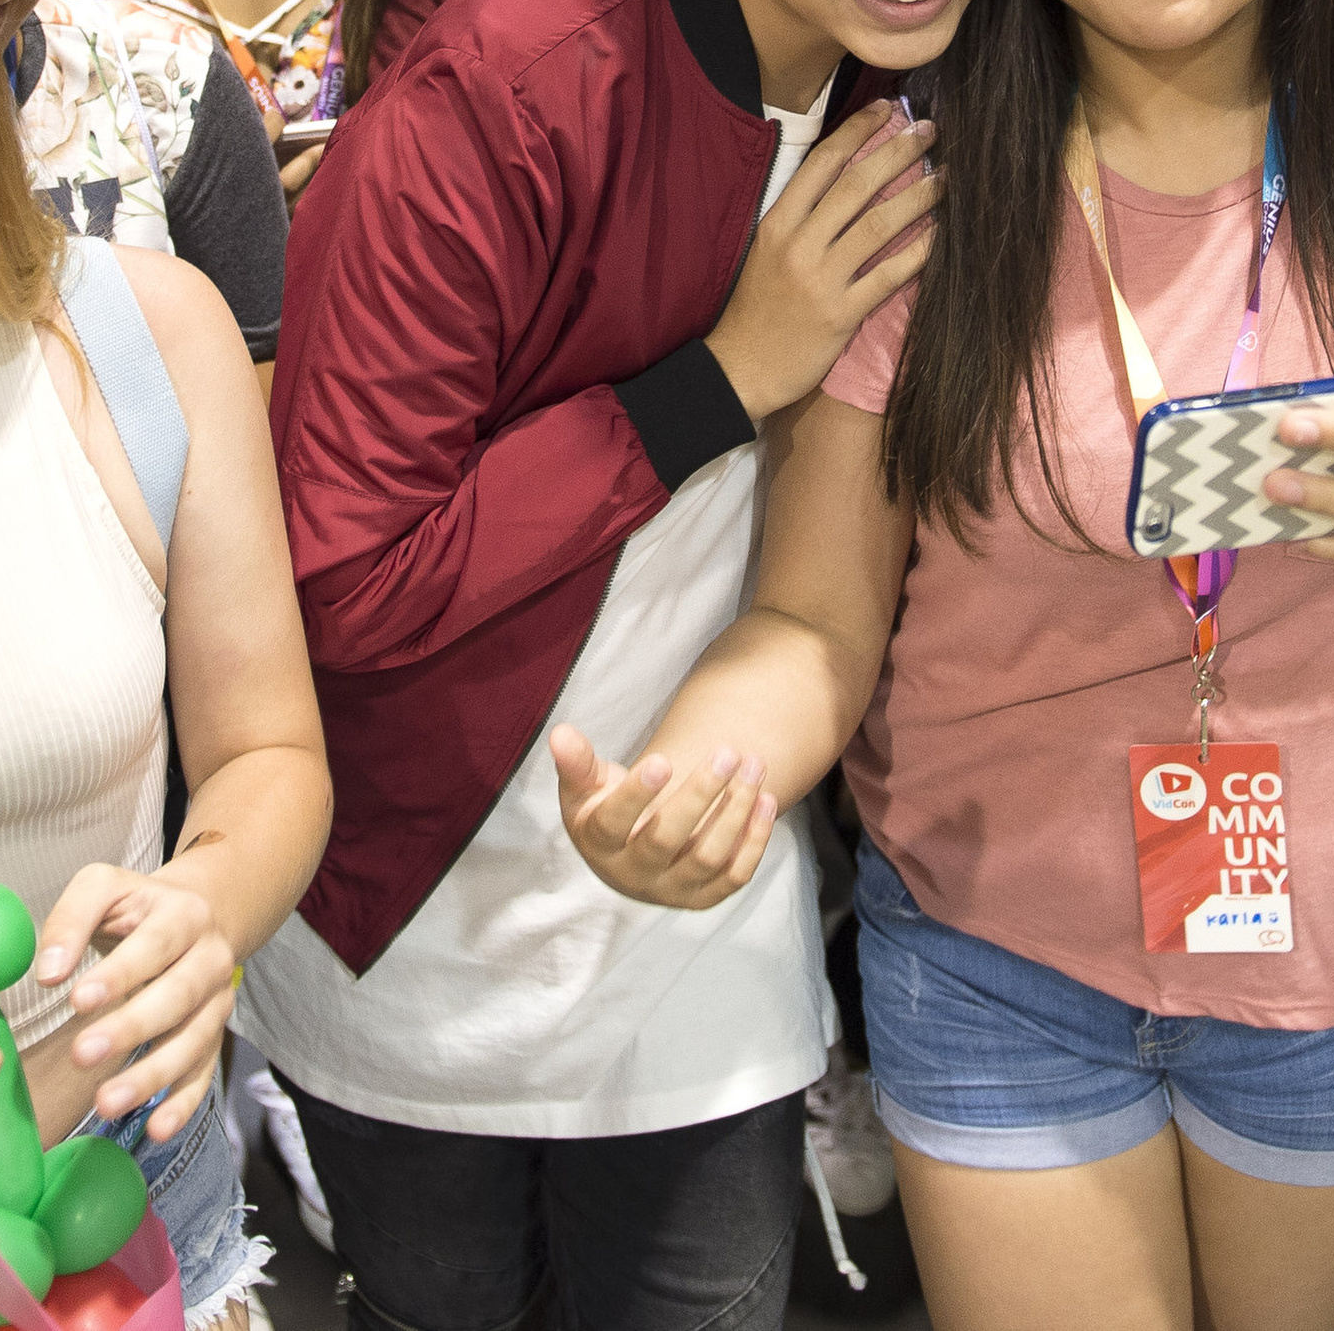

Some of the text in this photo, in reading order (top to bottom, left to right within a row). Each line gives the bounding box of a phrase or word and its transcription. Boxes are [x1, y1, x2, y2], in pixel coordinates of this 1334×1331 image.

[248, 76, 275, 112] NIUS
[323, 67, 345, 119] GENIU
[1262, 174, 1286, 256] GENIUS
[1221, 772, 1283, 803] CO
[1152, 799, 1196, 810] VidCon
[1208, 805, 1286, 835] MM
[1224, 837, 1287, 866] UN
[1219, 868, 1288, 896] ITY
